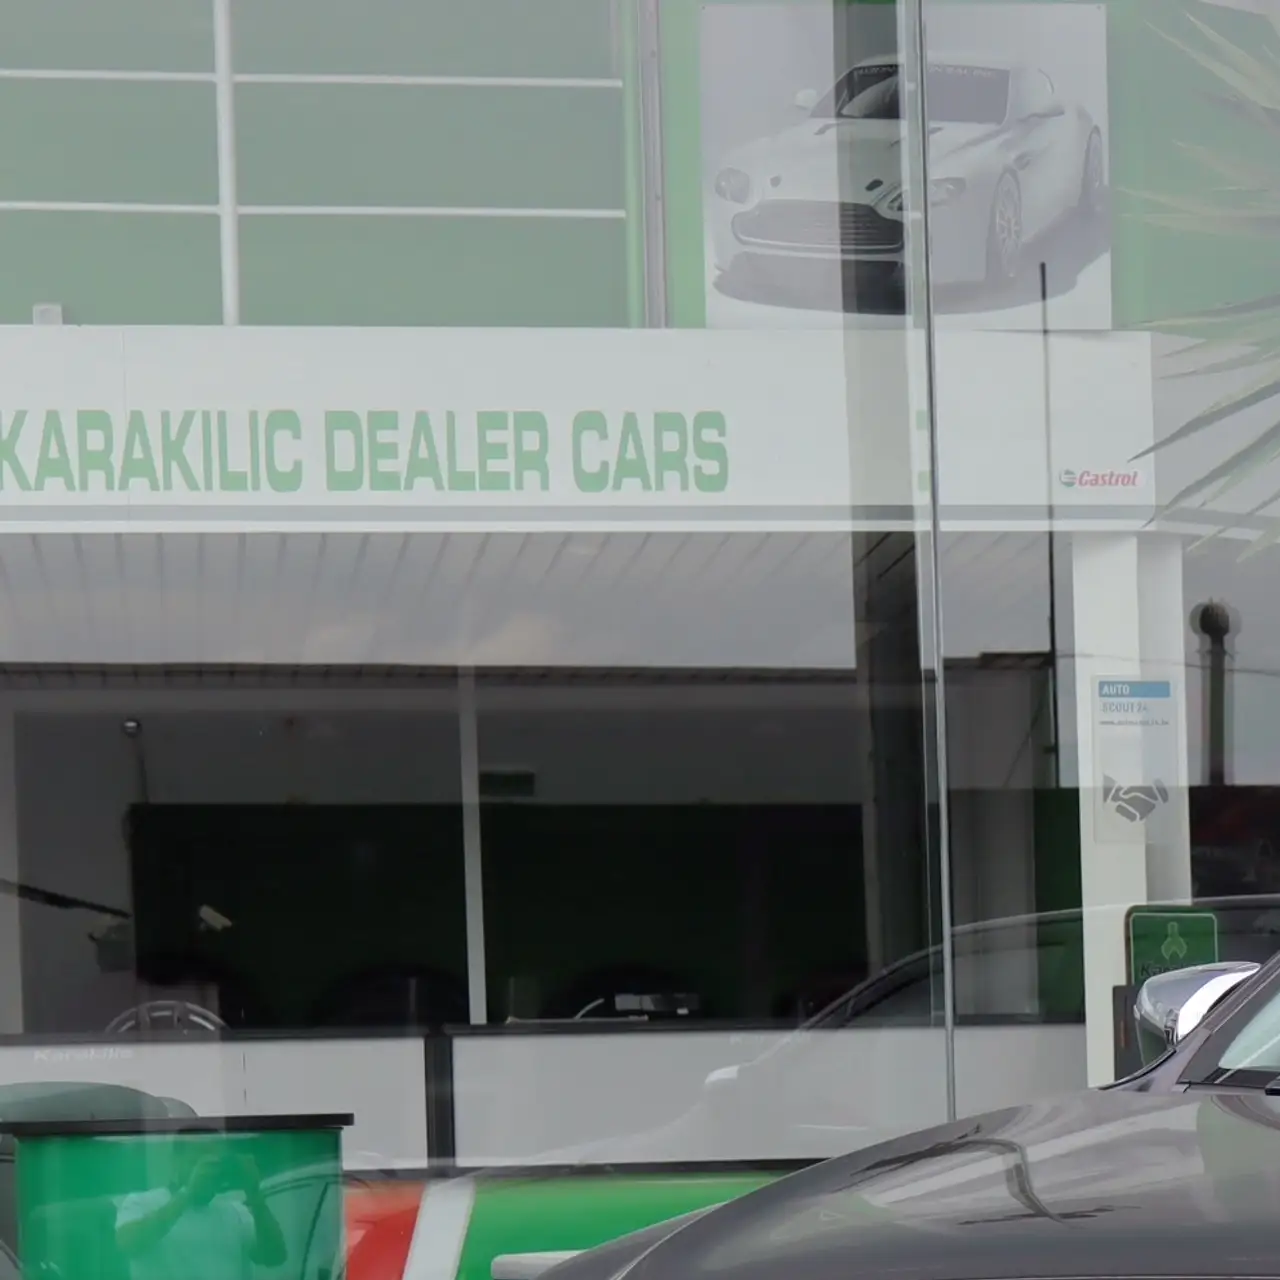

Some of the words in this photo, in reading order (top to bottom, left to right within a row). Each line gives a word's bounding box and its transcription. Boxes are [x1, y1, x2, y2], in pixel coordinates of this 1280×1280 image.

[0, 409, 303, 492] KARAKILIC
[324, 409, 549, 492] DEALER
[571, 409, 729, 493] CARS
[1077, 469, 1140, 487] Castrol
[1101, 683, 1131, 696] AUTO
